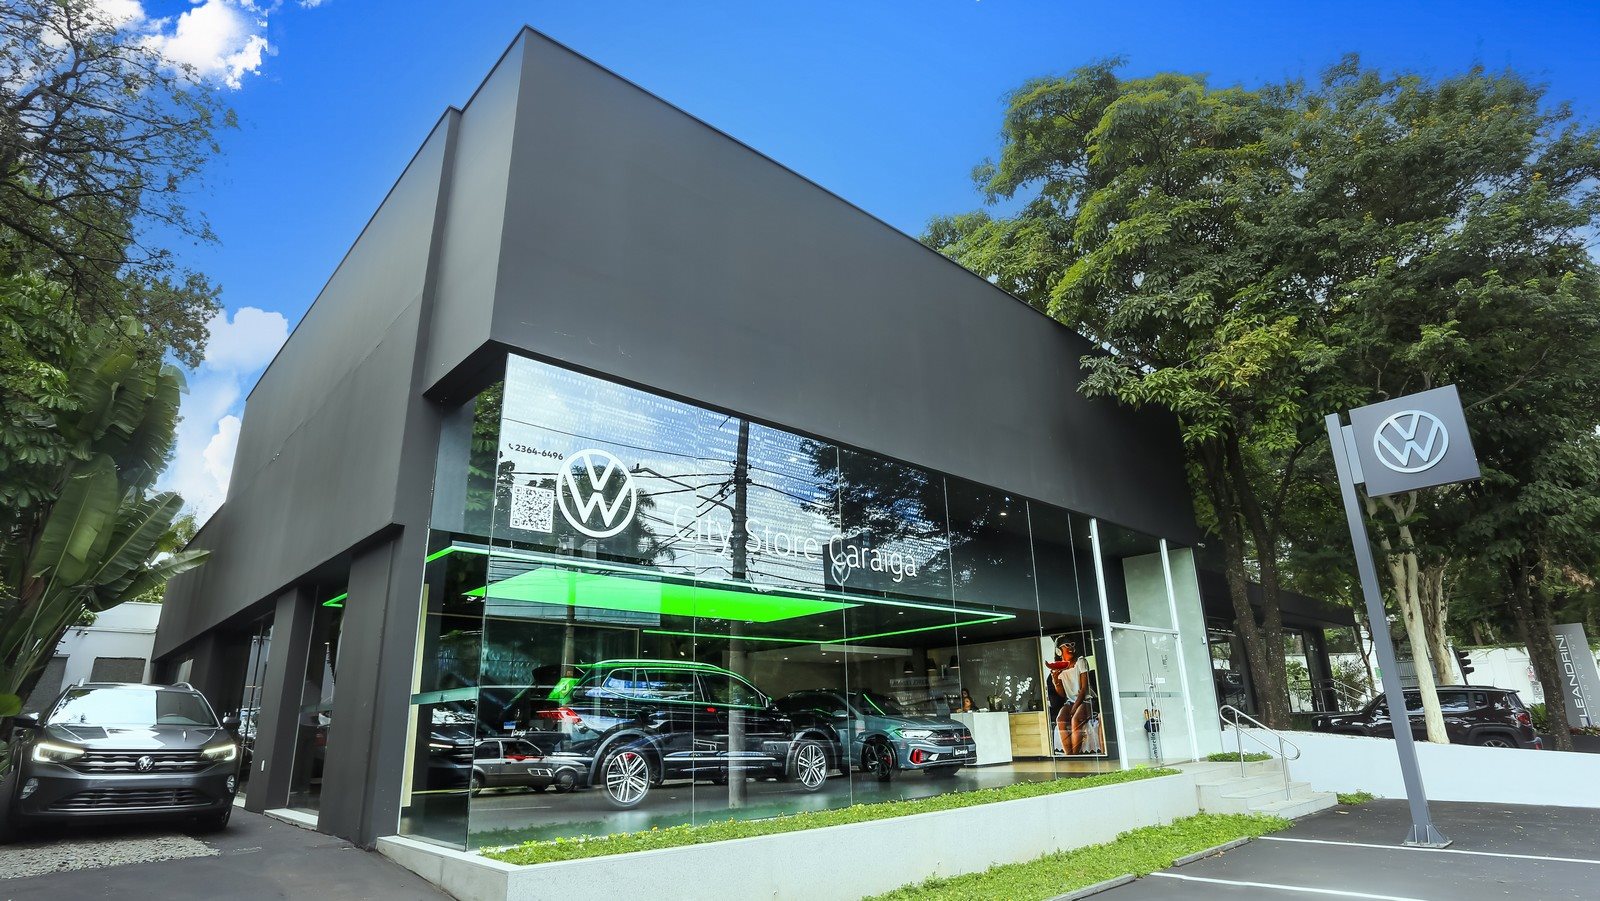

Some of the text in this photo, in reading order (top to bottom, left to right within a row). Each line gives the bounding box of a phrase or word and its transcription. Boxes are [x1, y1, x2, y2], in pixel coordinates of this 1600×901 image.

[515, 444, 564, 460] 2364-6496
[1375, 411, 1448, 471] VW
[557, 449, 636, 535] VW
[673, 505, 734, 557] City
[744, 518, 819, 561] Store
[1555, 634, 1588, 719] LEANDRINI
